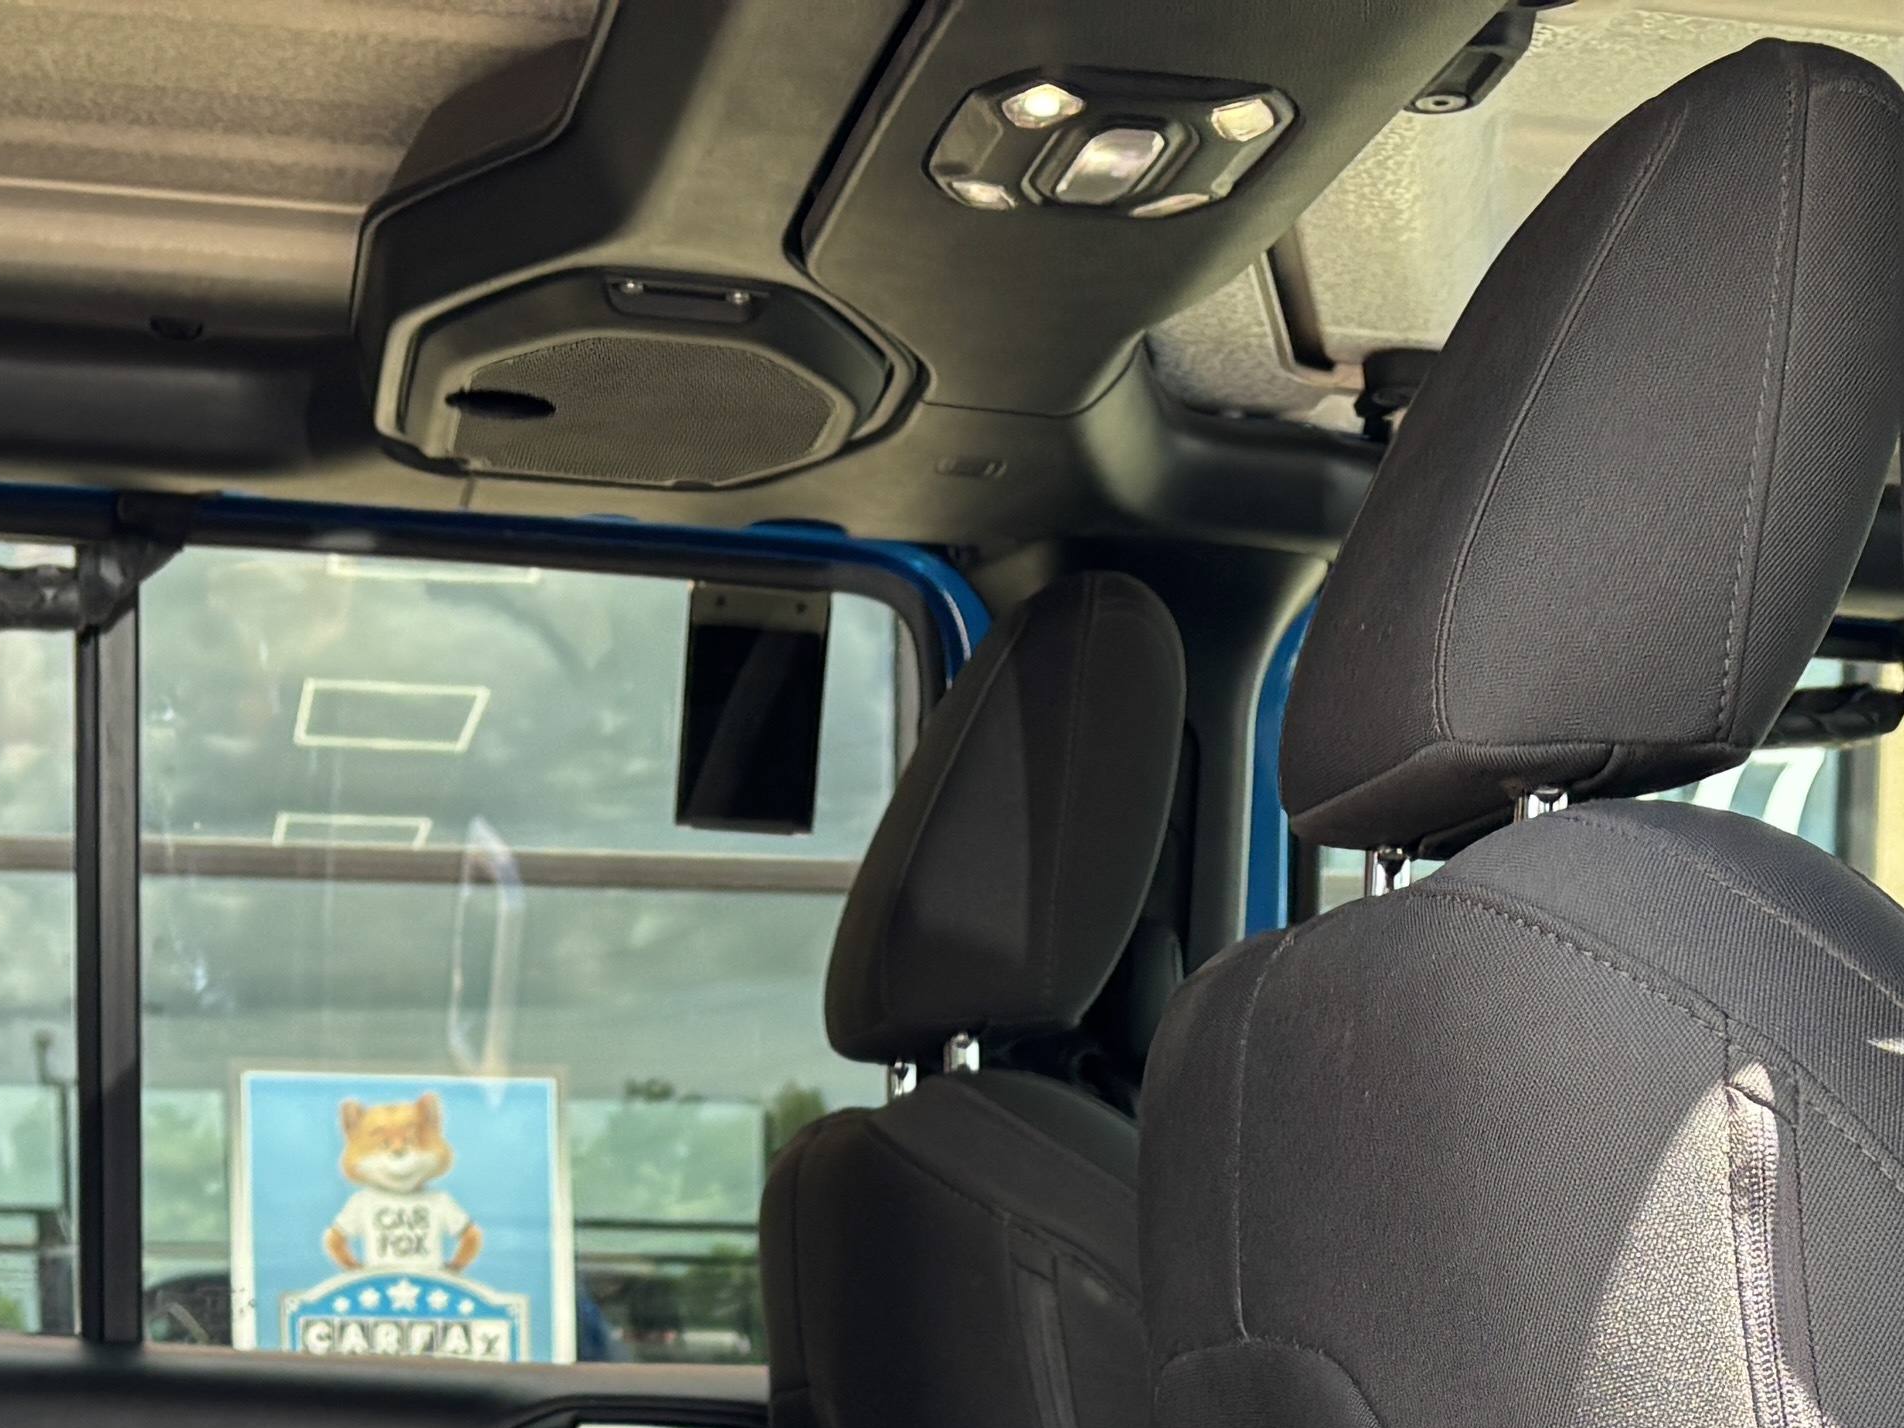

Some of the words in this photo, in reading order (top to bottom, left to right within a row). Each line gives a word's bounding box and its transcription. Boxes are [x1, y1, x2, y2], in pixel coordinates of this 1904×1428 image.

[373, 1206, 431, 1231] CAR
[377, 1233, 431, 1258] FOX
[305, 1321, 503, 1356] CARFAX
